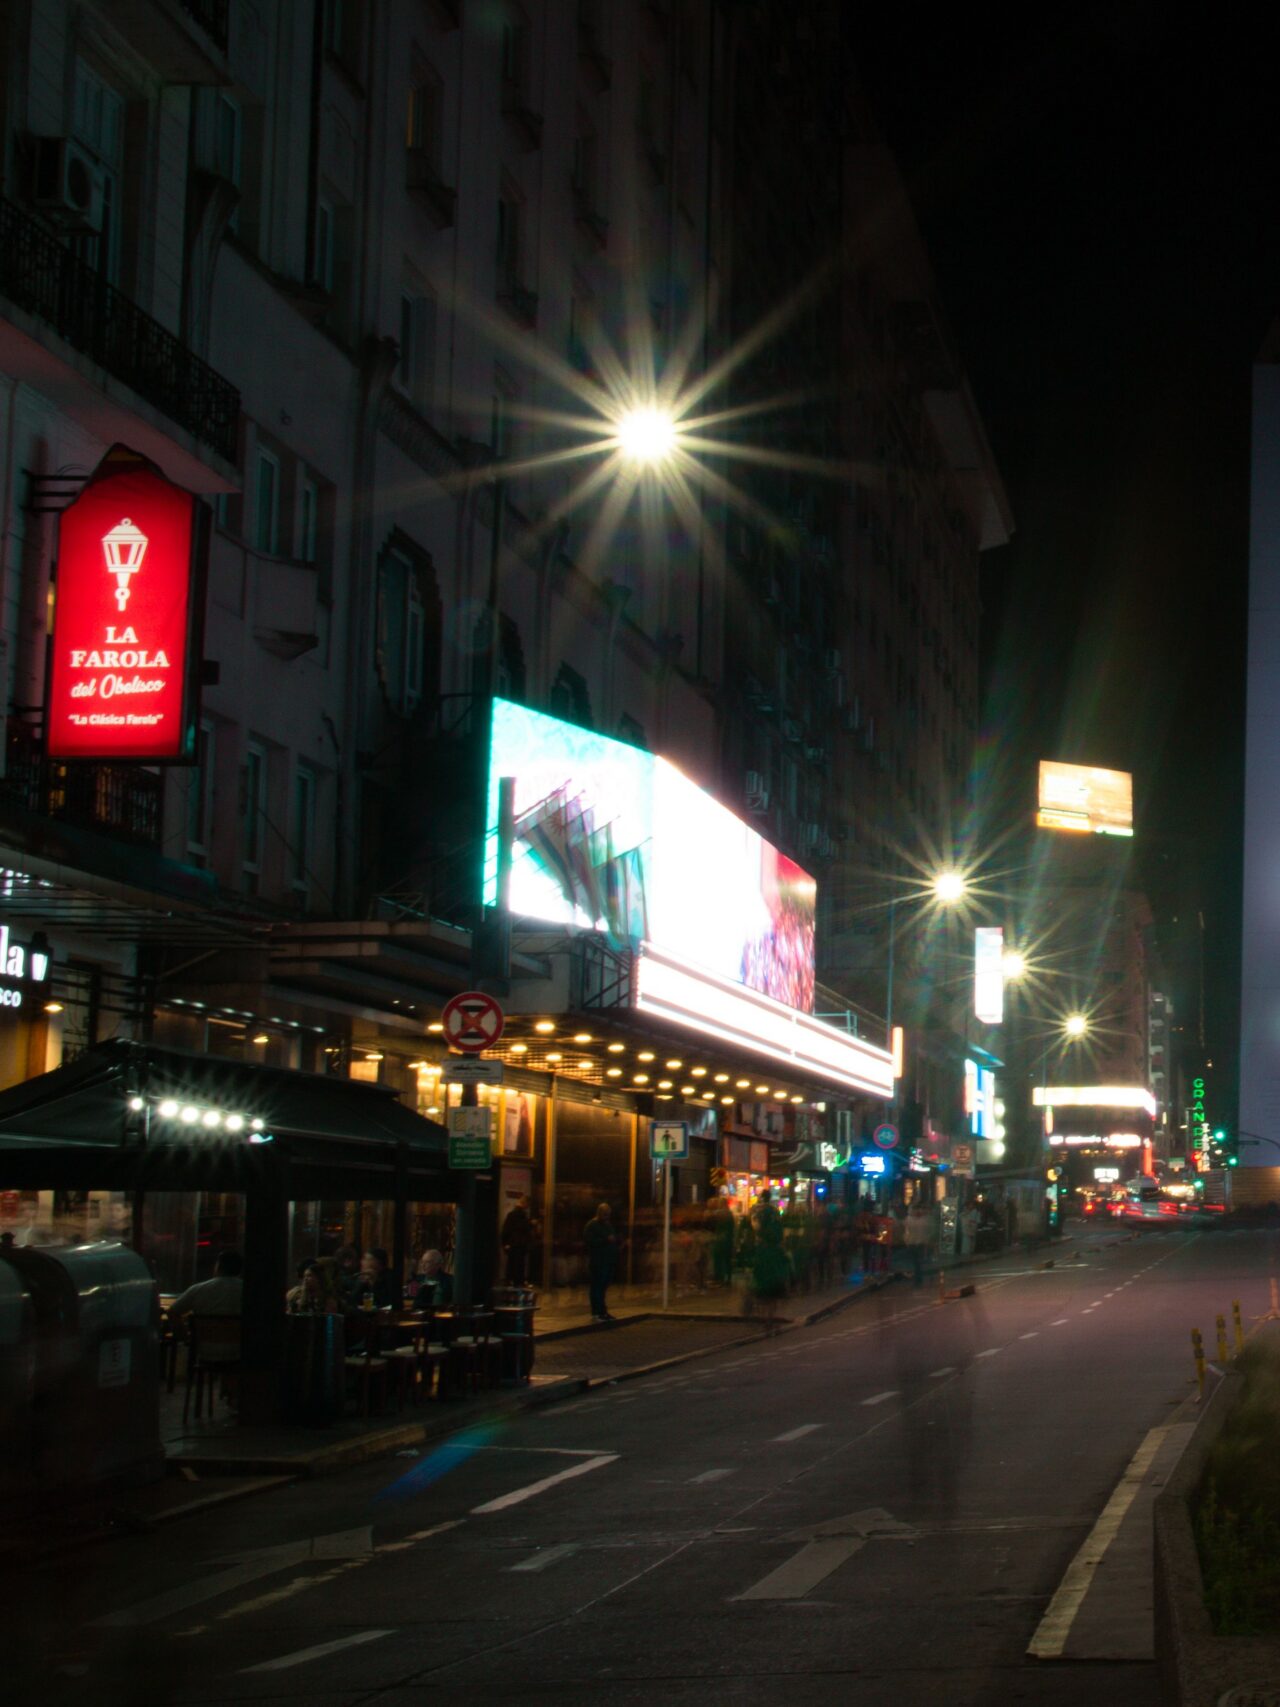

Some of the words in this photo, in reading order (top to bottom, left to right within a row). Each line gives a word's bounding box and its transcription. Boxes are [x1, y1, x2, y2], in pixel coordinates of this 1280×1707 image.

[105, 626, 139, 644] LA
[70, 650, 170, 668] FAROLA
[71, 678, 97, 698] del
[99, 673, 166, 699] Obelisco
